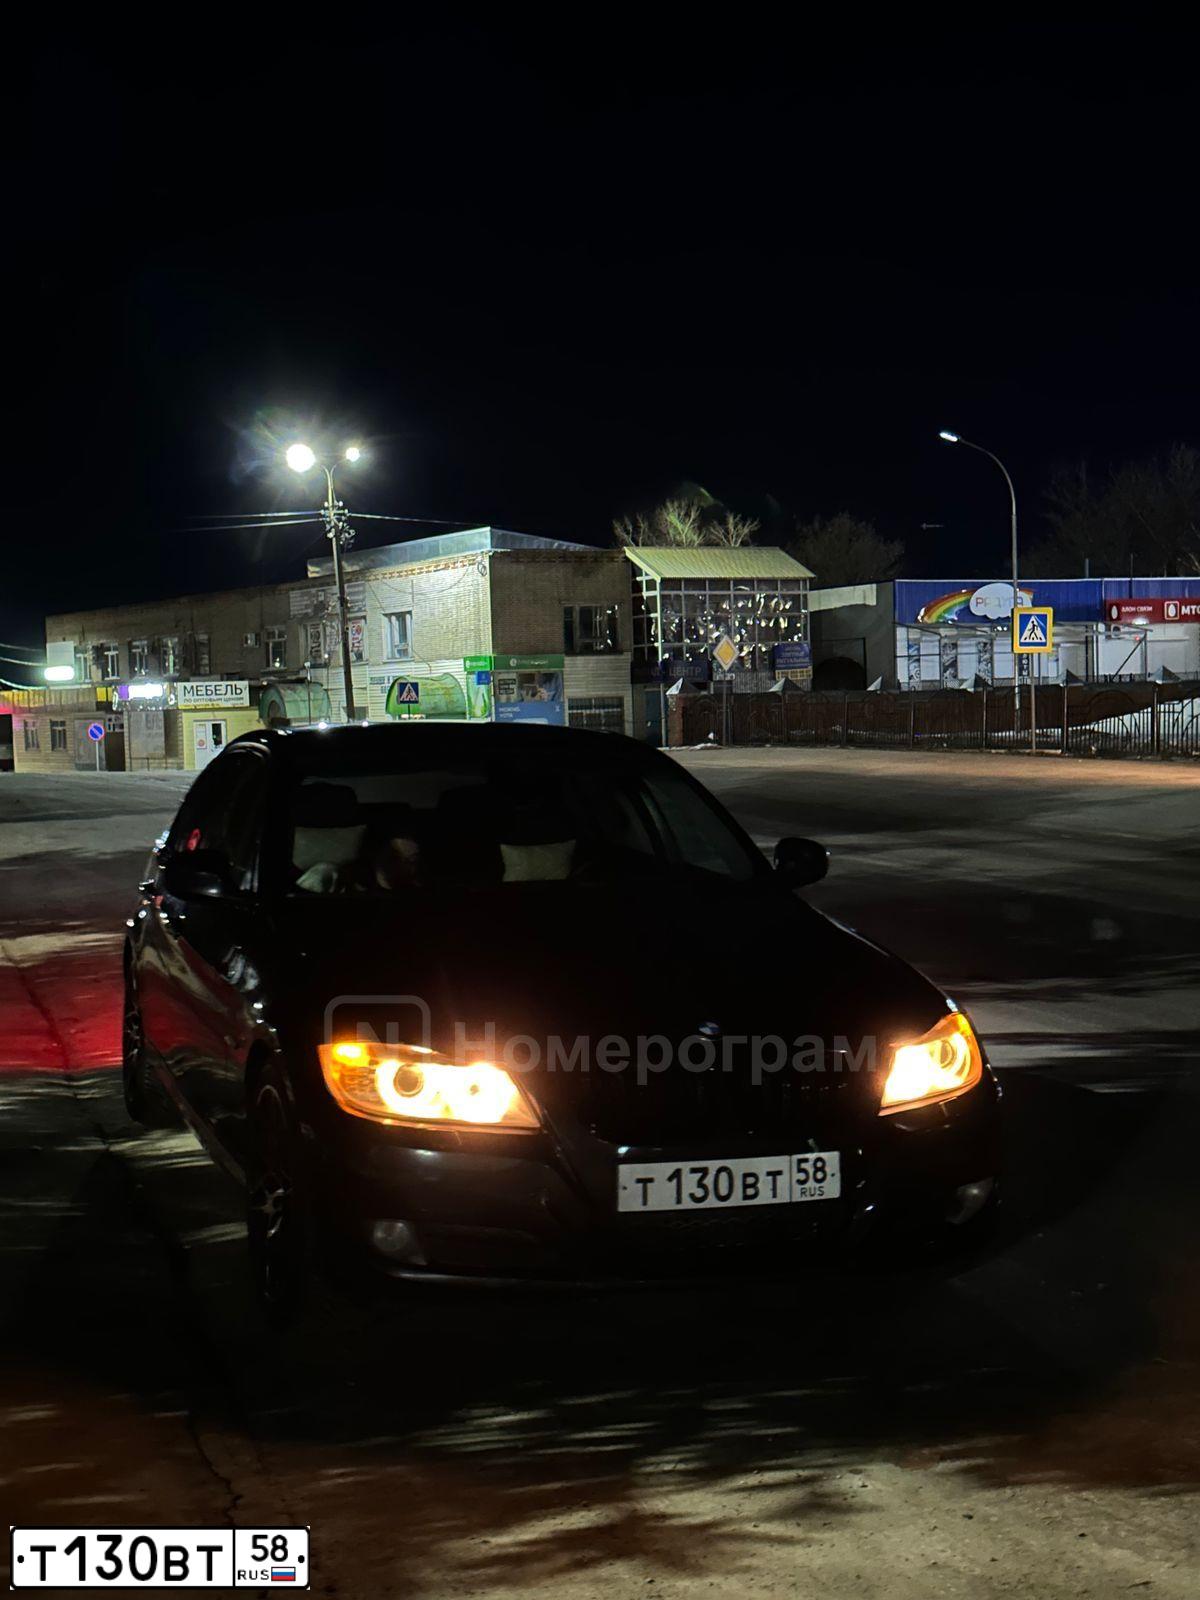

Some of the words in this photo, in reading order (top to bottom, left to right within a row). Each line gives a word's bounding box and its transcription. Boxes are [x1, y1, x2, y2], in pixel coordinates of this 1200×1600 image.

[183, 684, 244, 697] МЕБЕЛЬ
[635, 1166, 783, 1206] Т130ВТ
[796, 1157, 828, 1185] 58
[800, 1186, 825, 1198] RUS
